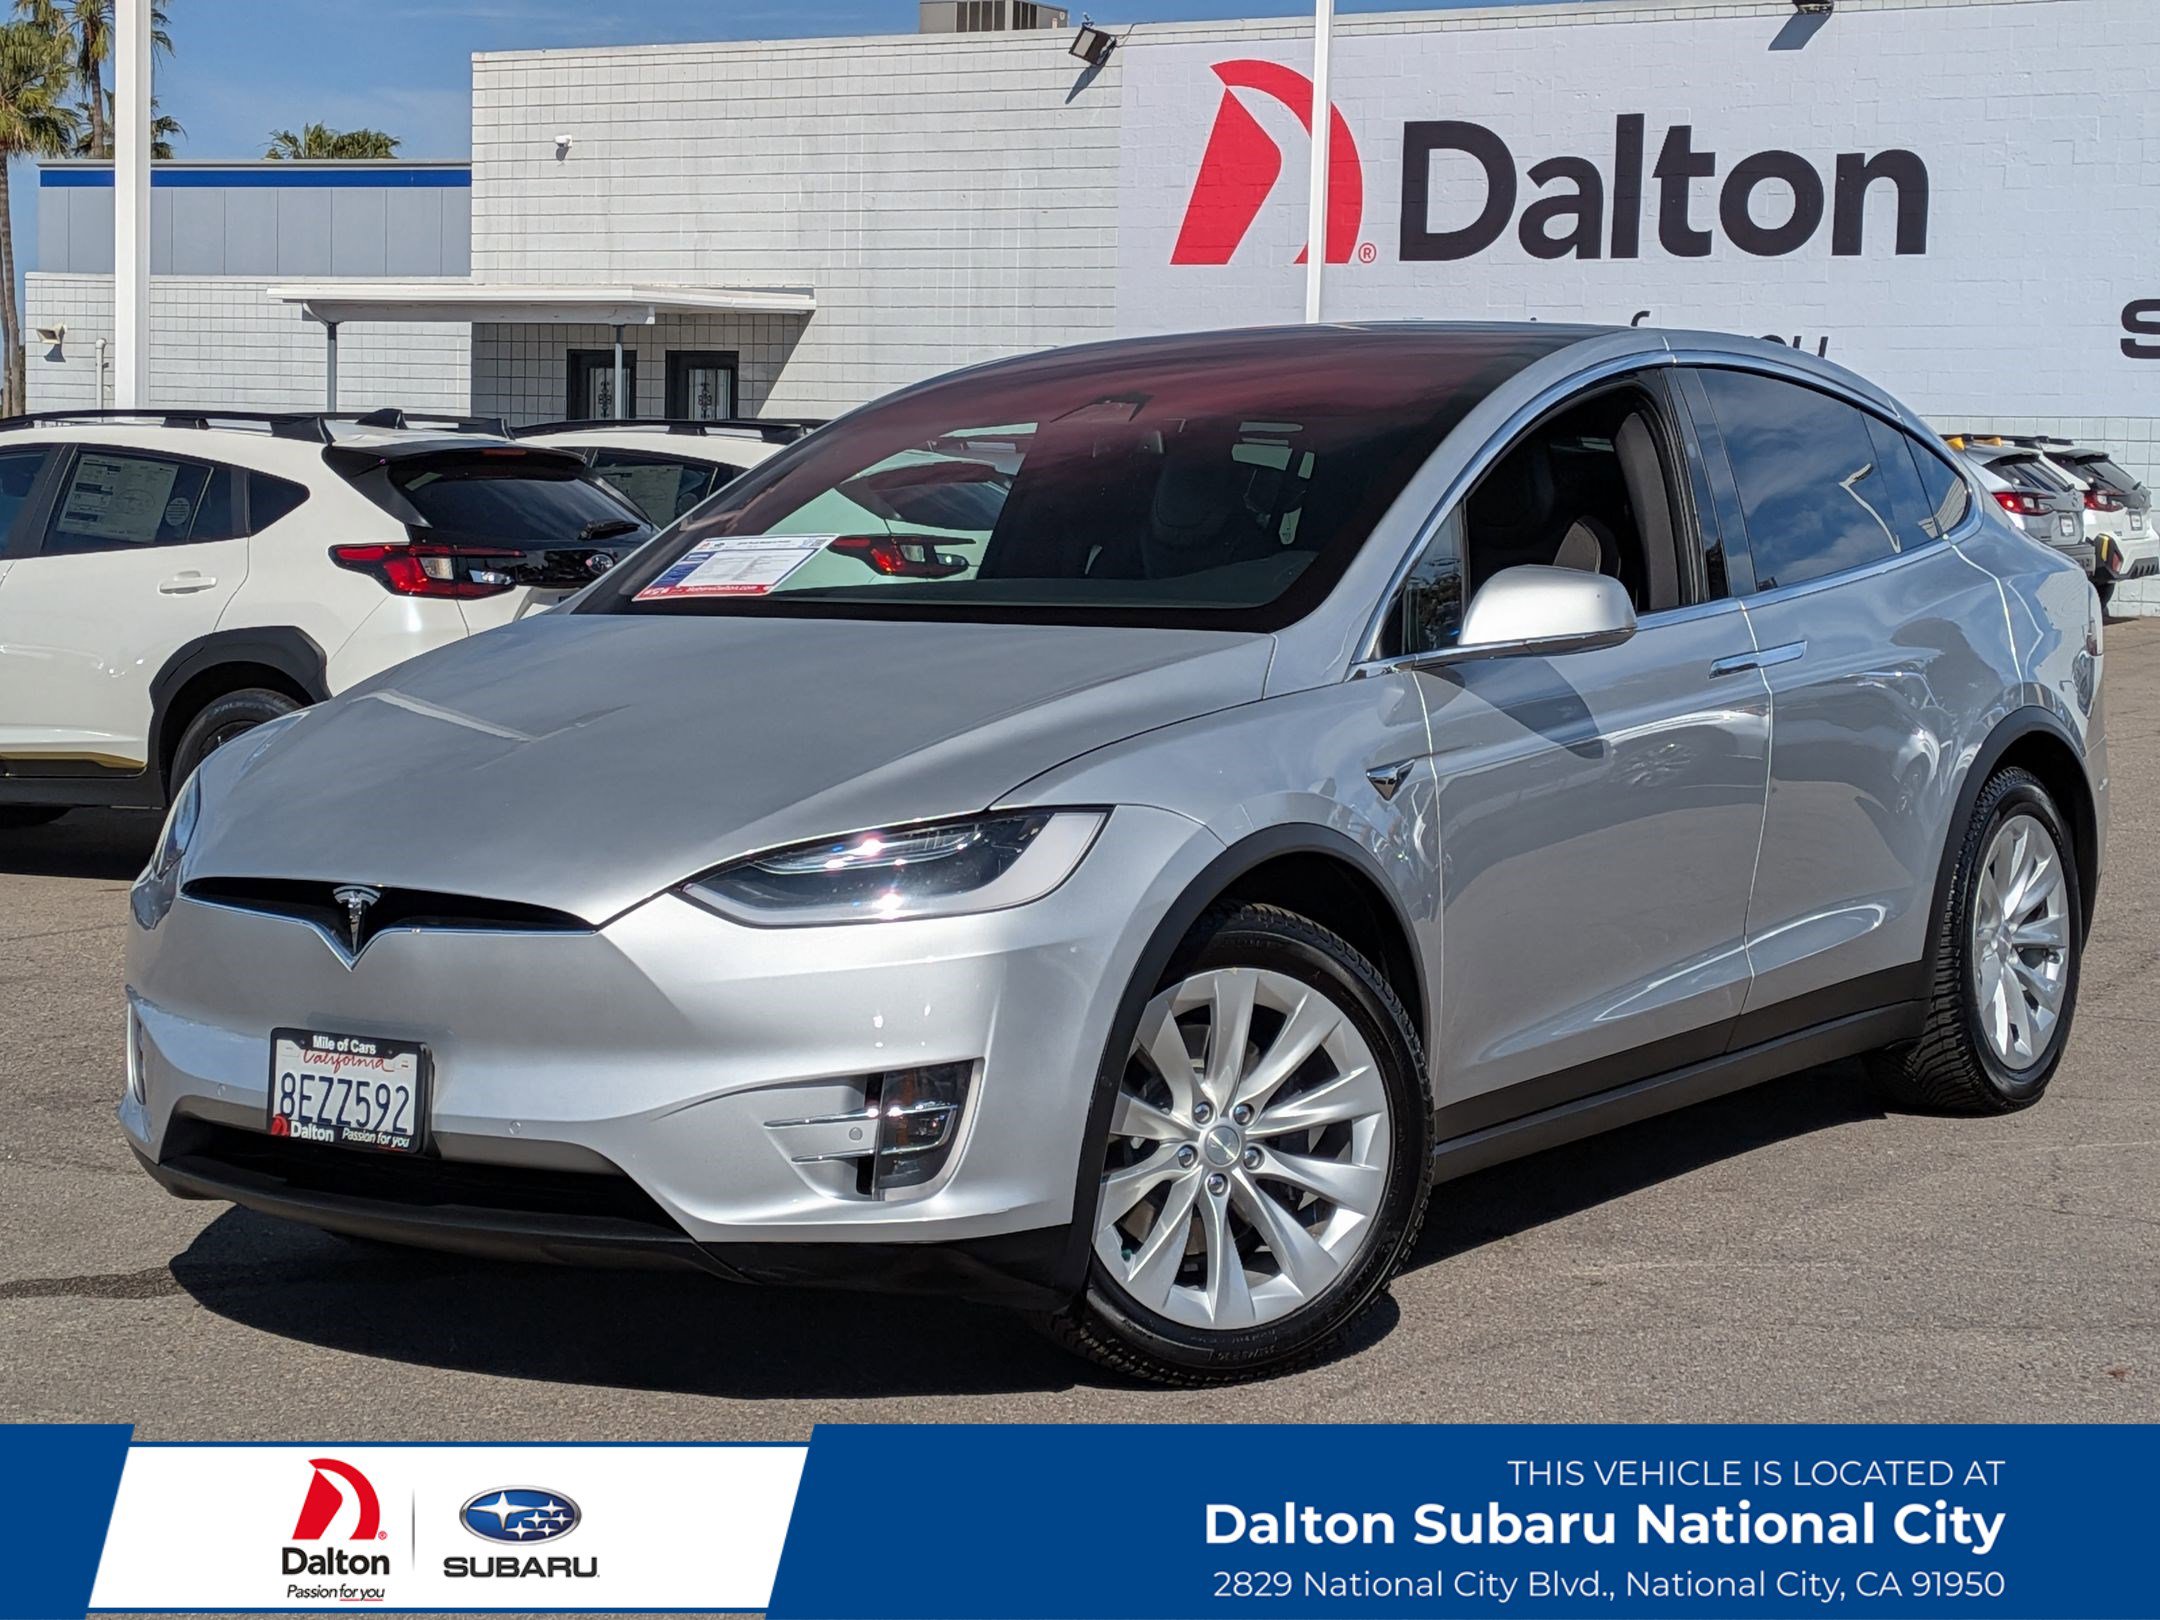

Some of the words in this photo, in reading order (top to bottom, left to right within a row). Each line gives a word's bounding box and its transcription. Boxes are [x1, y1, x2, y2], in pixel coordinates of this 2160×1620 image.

[1400, 114, 1929, 262] Dalton
[313, 1035, 335, 1050] Mile
[337, 1038, 350, 1052] of
[350, 1039, 376, 1055] Cars
[280, 1072, 410, 1133] 8EZZ592
[290, 1121, 334, 1142] Dalton
[342, 1127, 376, 1144] Passion
[377, 1131, 391, 1145] for
[392, 1135, 410, 1148] you
